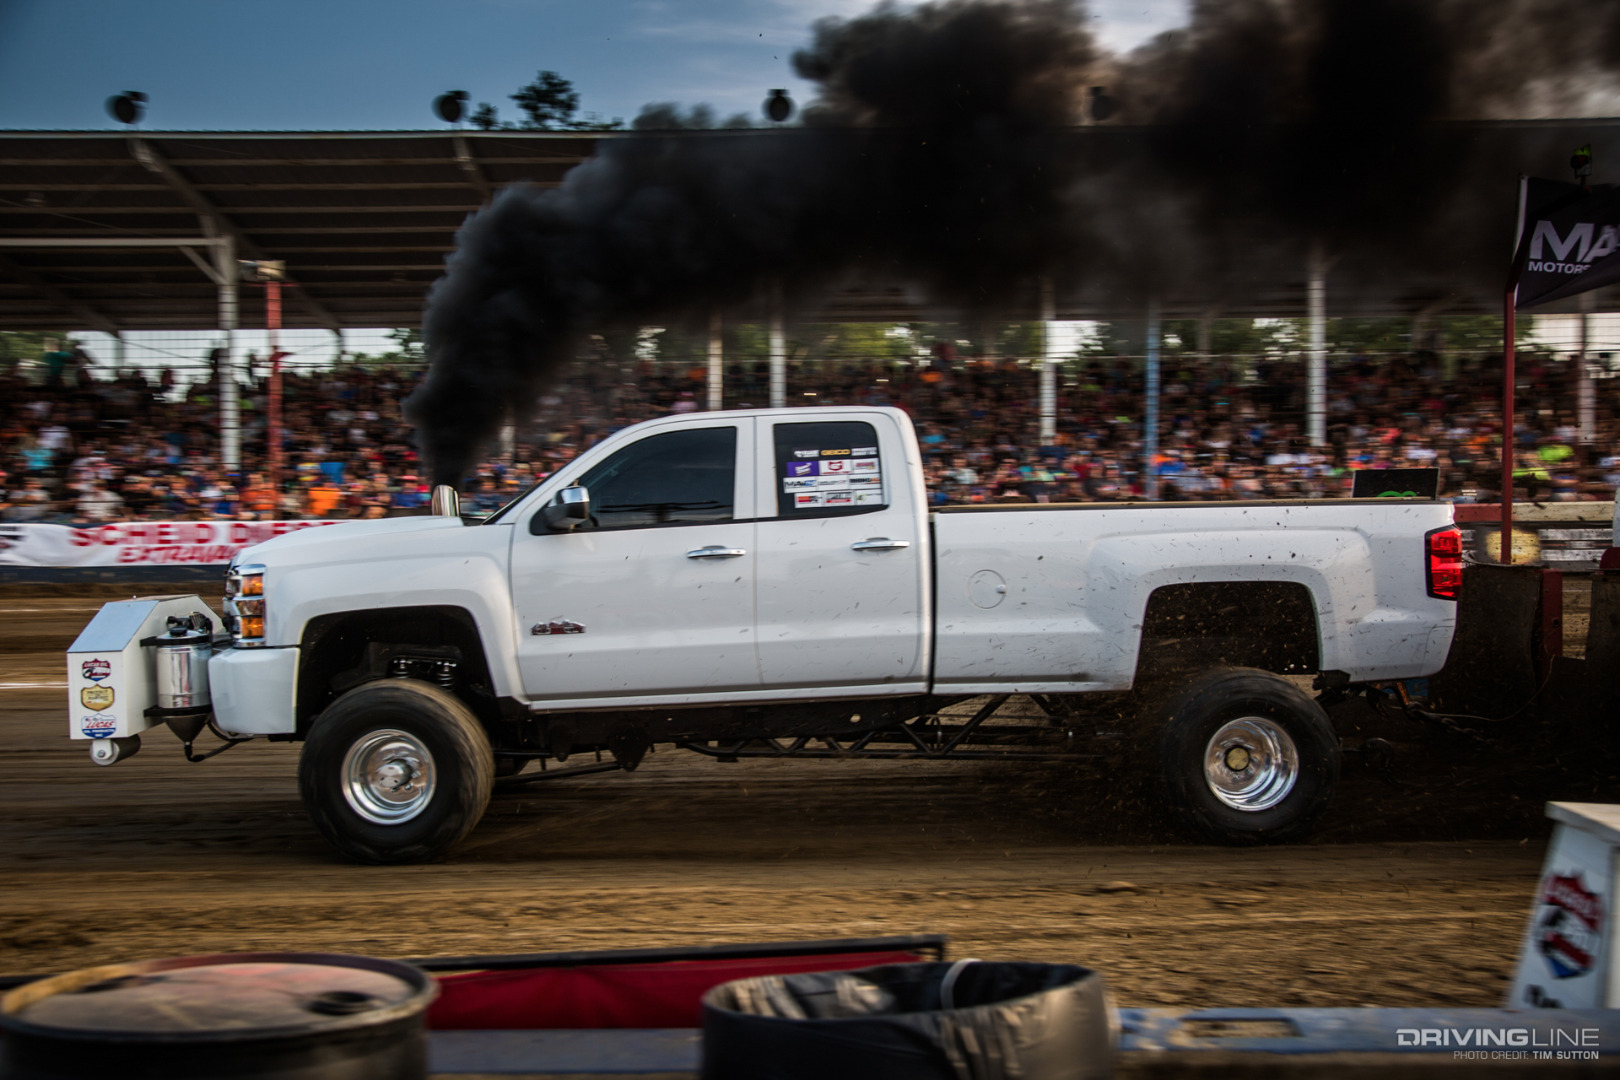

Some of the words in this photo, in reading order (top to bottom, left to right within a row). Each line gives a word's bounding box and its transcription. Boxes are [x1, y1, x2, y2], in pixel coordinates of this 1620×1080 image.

[1528, 219, 1620, 263] MA
[71, 523, 216, 546] SCHEID
[86, 720, 114, 729] LUCAS
